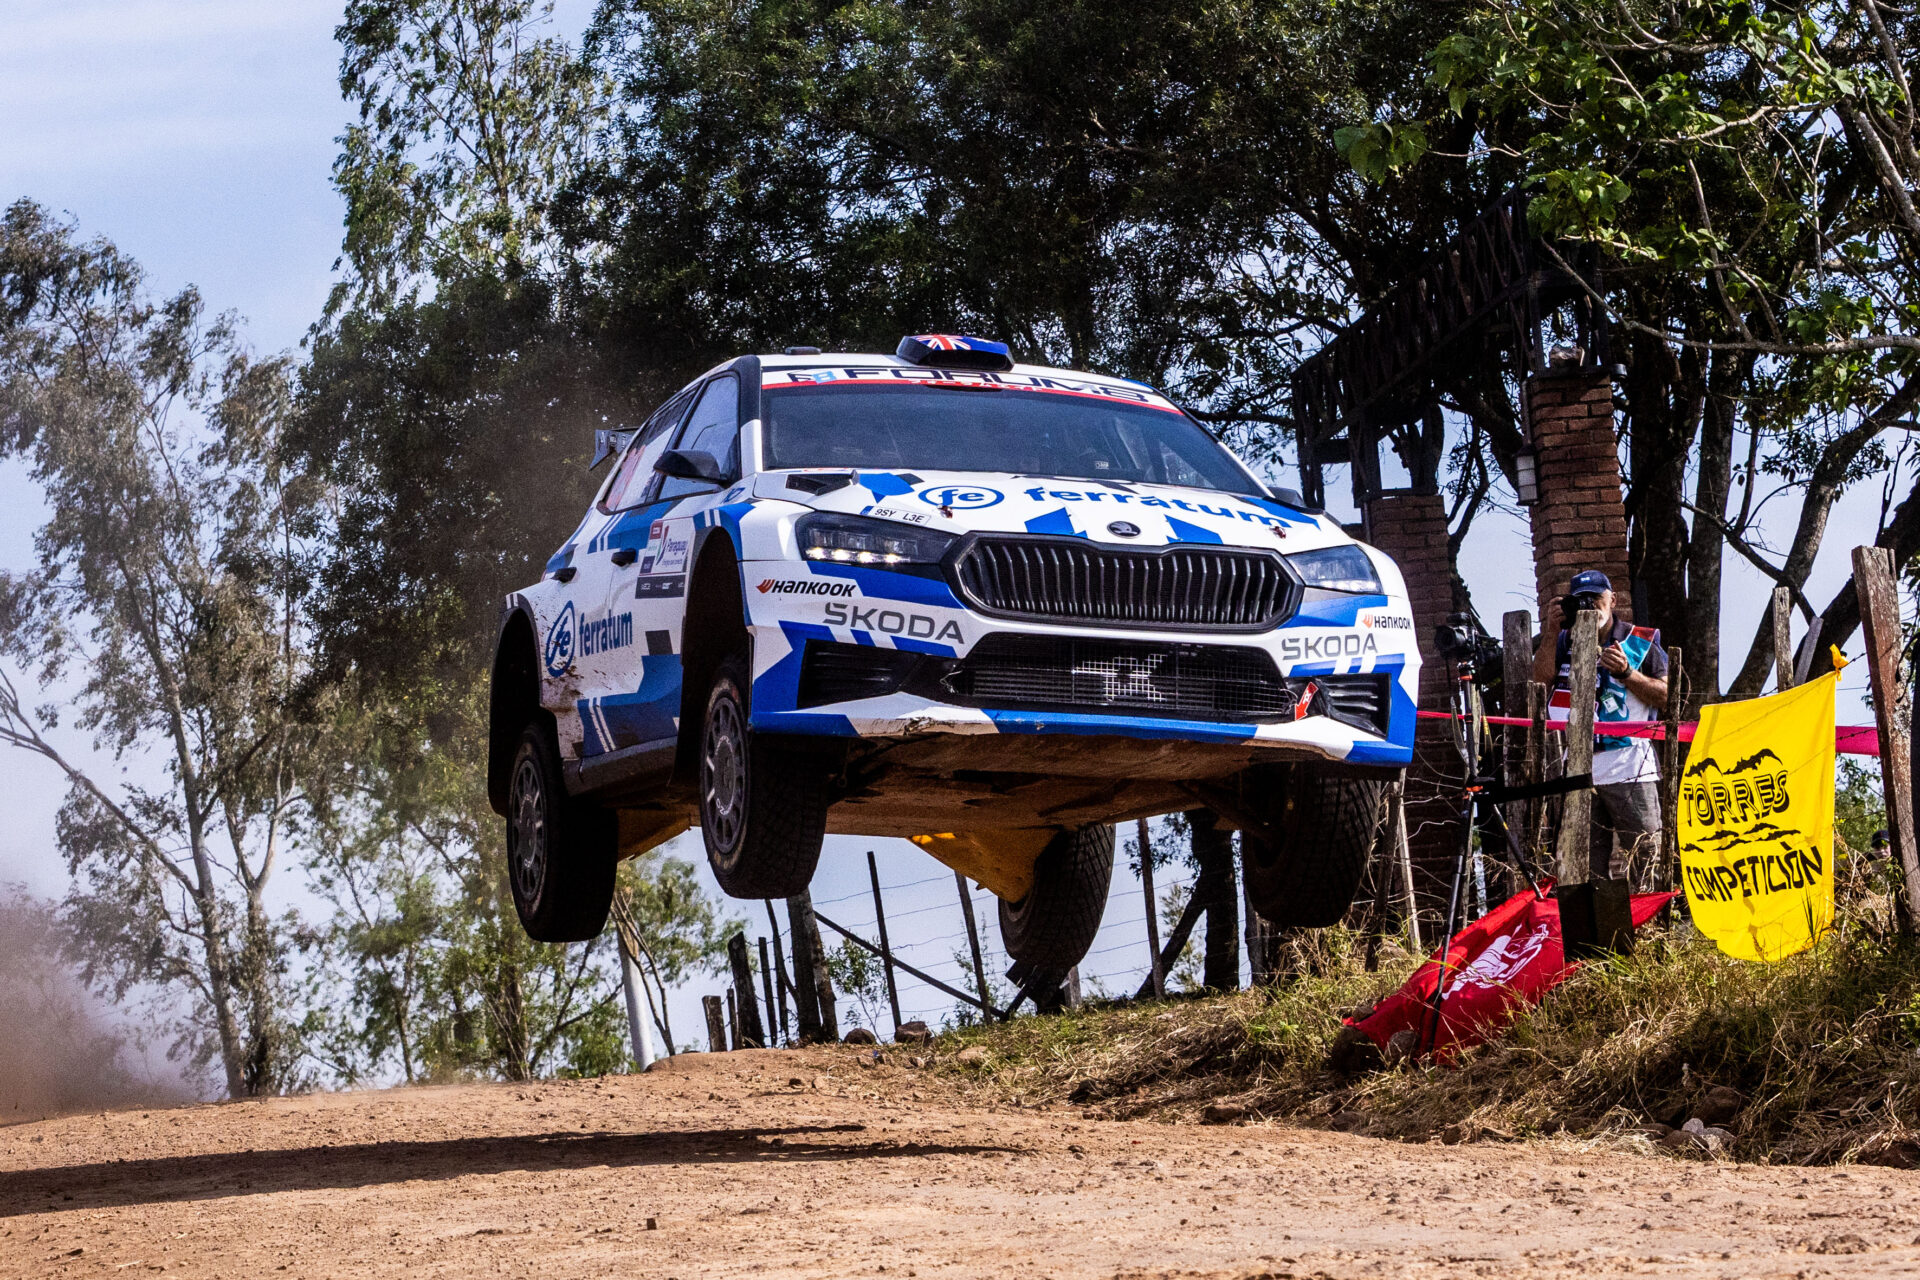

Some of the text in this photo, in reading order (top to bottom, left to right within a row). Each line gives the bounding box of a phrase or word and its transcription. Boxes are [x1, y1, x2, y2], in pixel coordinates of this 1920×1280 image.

[874, 508, 925, 523] 9SY L3E
[1024, 487, 1292, 528] ferratum
[579, 610, 633, 657] ferratum
[1683, 769, 1790, 828] TORRES
